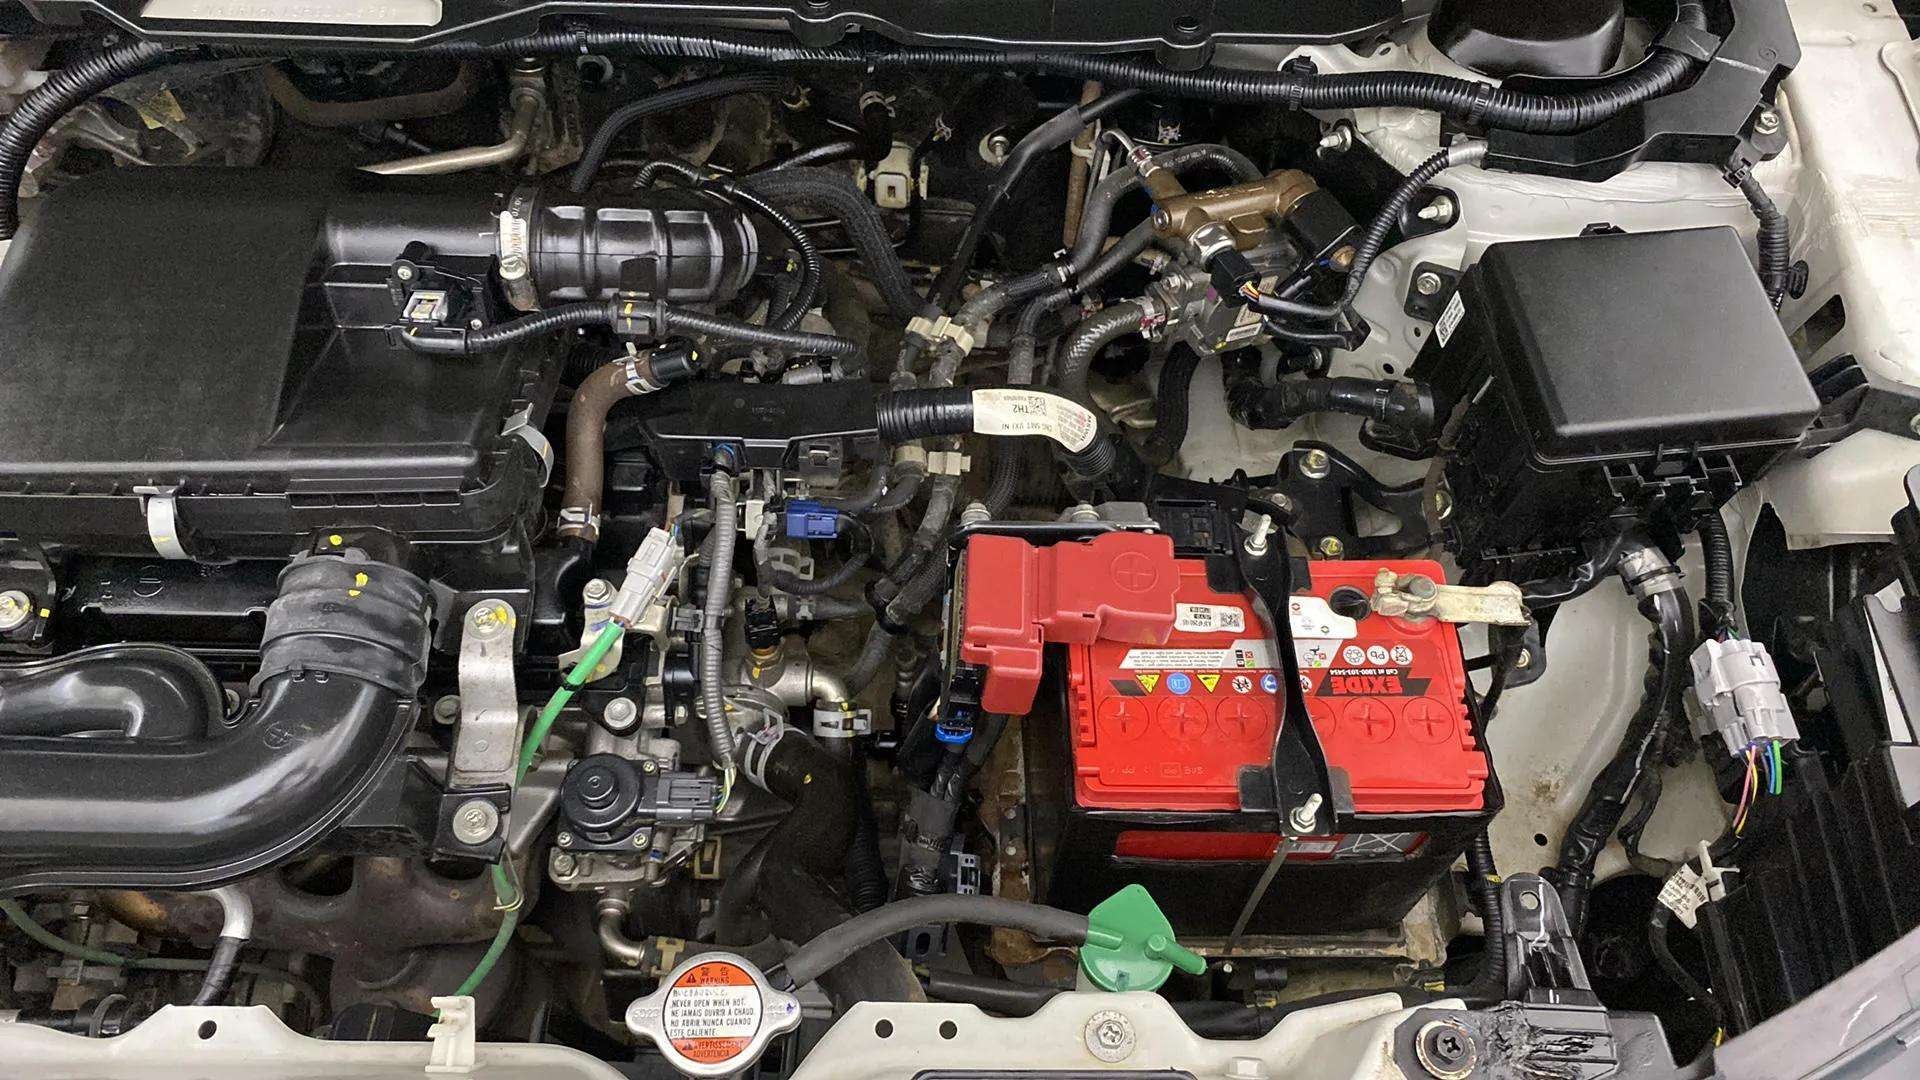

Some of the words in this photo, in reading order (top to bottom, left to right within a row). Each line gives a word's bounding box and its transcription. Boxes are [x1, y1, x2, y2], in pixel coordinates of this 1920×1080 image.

[1371, 650, 1386, 660] Pb
[1385, 668, 1398, 676] Call
[1330, 676, 1403, 694] EXIDE
[700, 976, 730, 984] WARNING
[694, 999, 710, 1007] OPEN
[713, 999, 730, 1007] WHEN
[671, 1009, 680, 1017] NE
[681, 1009, 702, 1017] JAMAIS
[671, 1019, 679, 1027] NO
[682, 1019, 700, 1027] ABRIR
[703, 1019, 723, 1027] NUNCA
[726, 1018, 752, 1026] CUANDO
